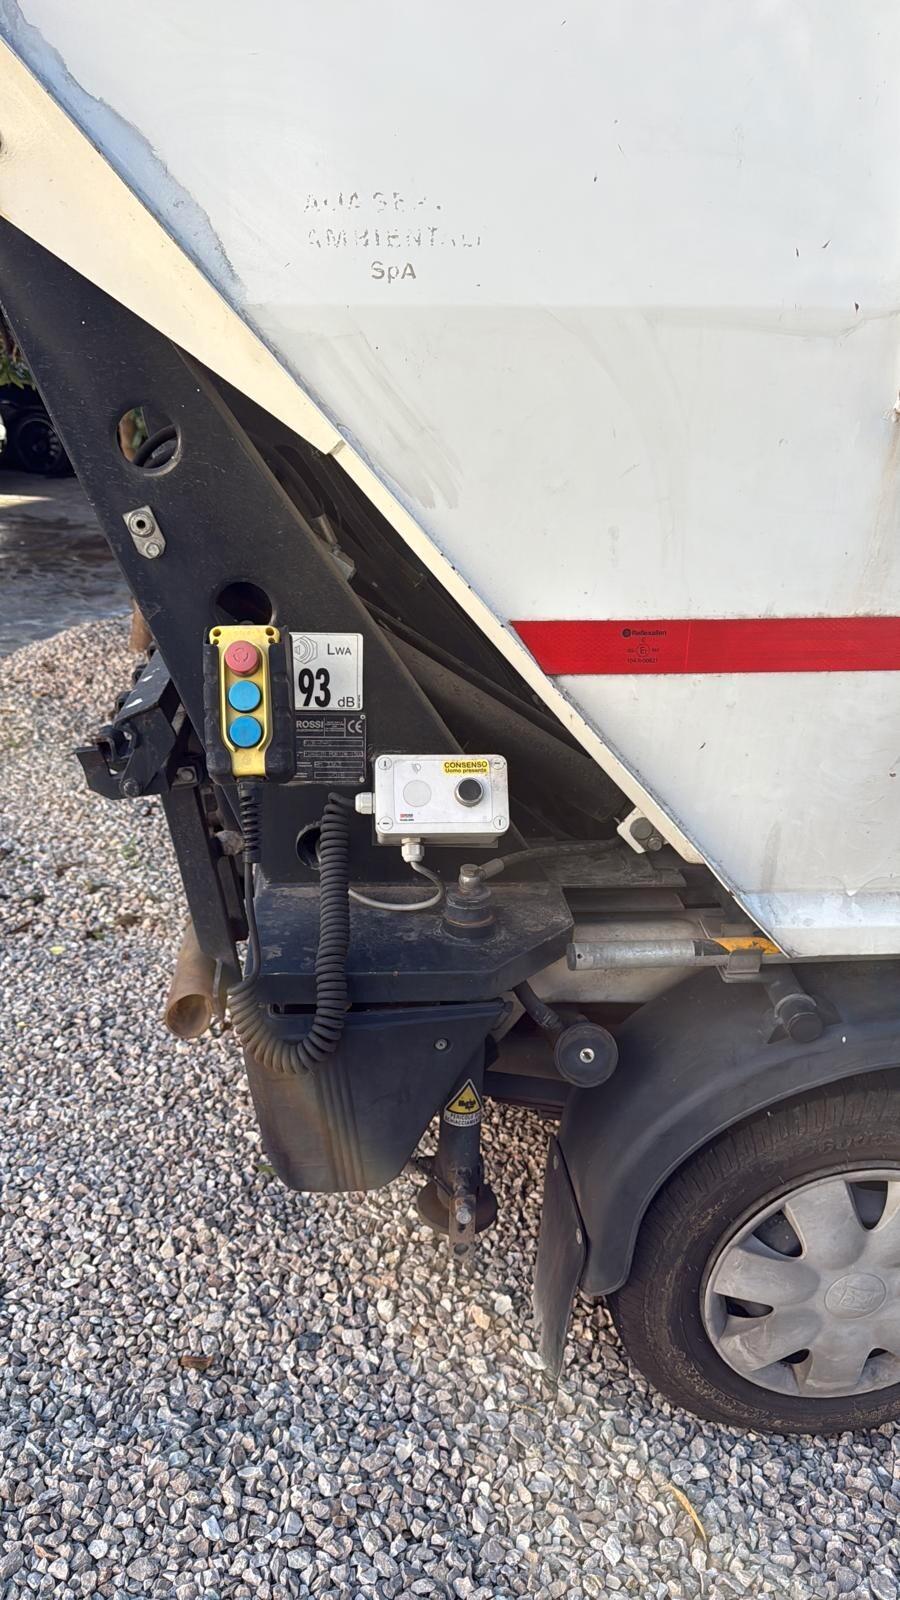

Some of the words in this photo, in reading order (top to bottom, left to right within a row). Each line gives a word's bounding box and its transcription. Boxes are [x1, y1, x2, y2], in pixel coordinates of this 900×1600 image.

[371, 261, 417, 284] SpA
[327, 643, 352, 655] LWA
[298, 668, 331, 707] 93
[337, 697, 355, 708] dB
[296, 721, 324, 729] ROSSI
